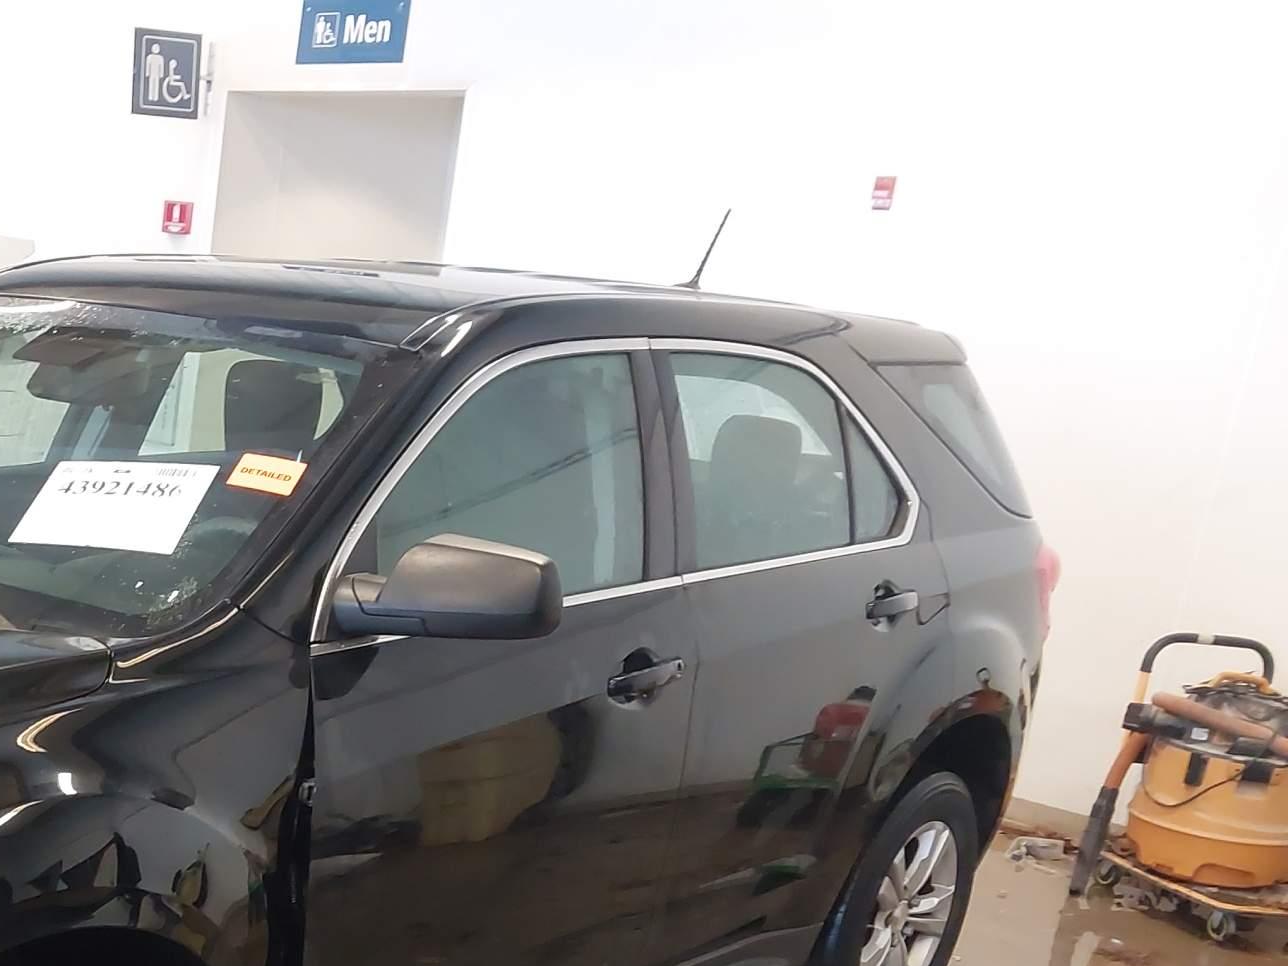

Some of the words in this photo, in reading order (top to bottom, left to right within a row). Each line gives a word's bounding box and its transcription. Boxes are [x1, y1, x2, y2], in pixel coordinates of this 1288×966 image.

[342, 14, 392, 44] Men
[239, 466, 293, 482] DETAILED
[58, 480, 182, 497] 43921486
